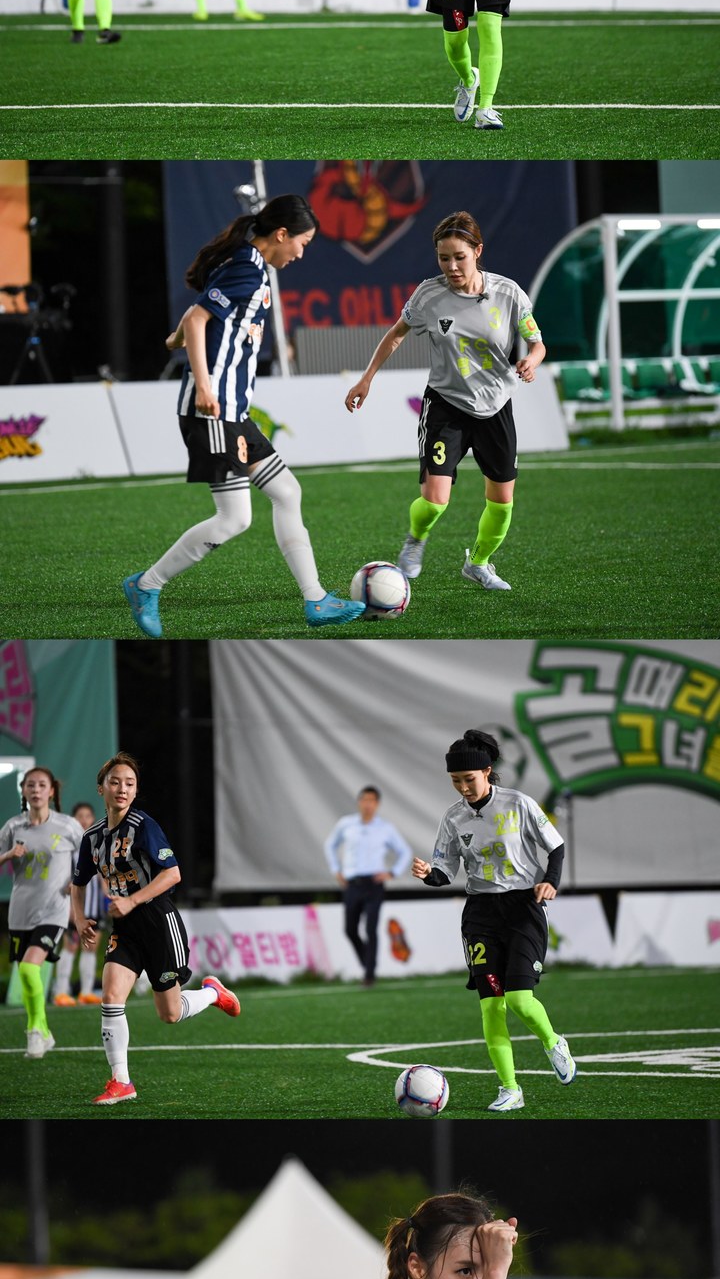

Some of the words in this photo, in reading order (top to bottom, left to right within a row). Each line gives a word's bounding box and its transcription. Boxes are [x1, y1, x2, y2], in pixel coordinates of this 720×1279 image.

[280, 288, 332, 331] FC
[488, 307, 501, 330] 3
[525, 319, 537, 332] C
[459, 337, 489, 353] FC
[433, 441, 446, 466] 3
[493, 810, 519, 836] 22
[481, 842, 506, 861] FC
